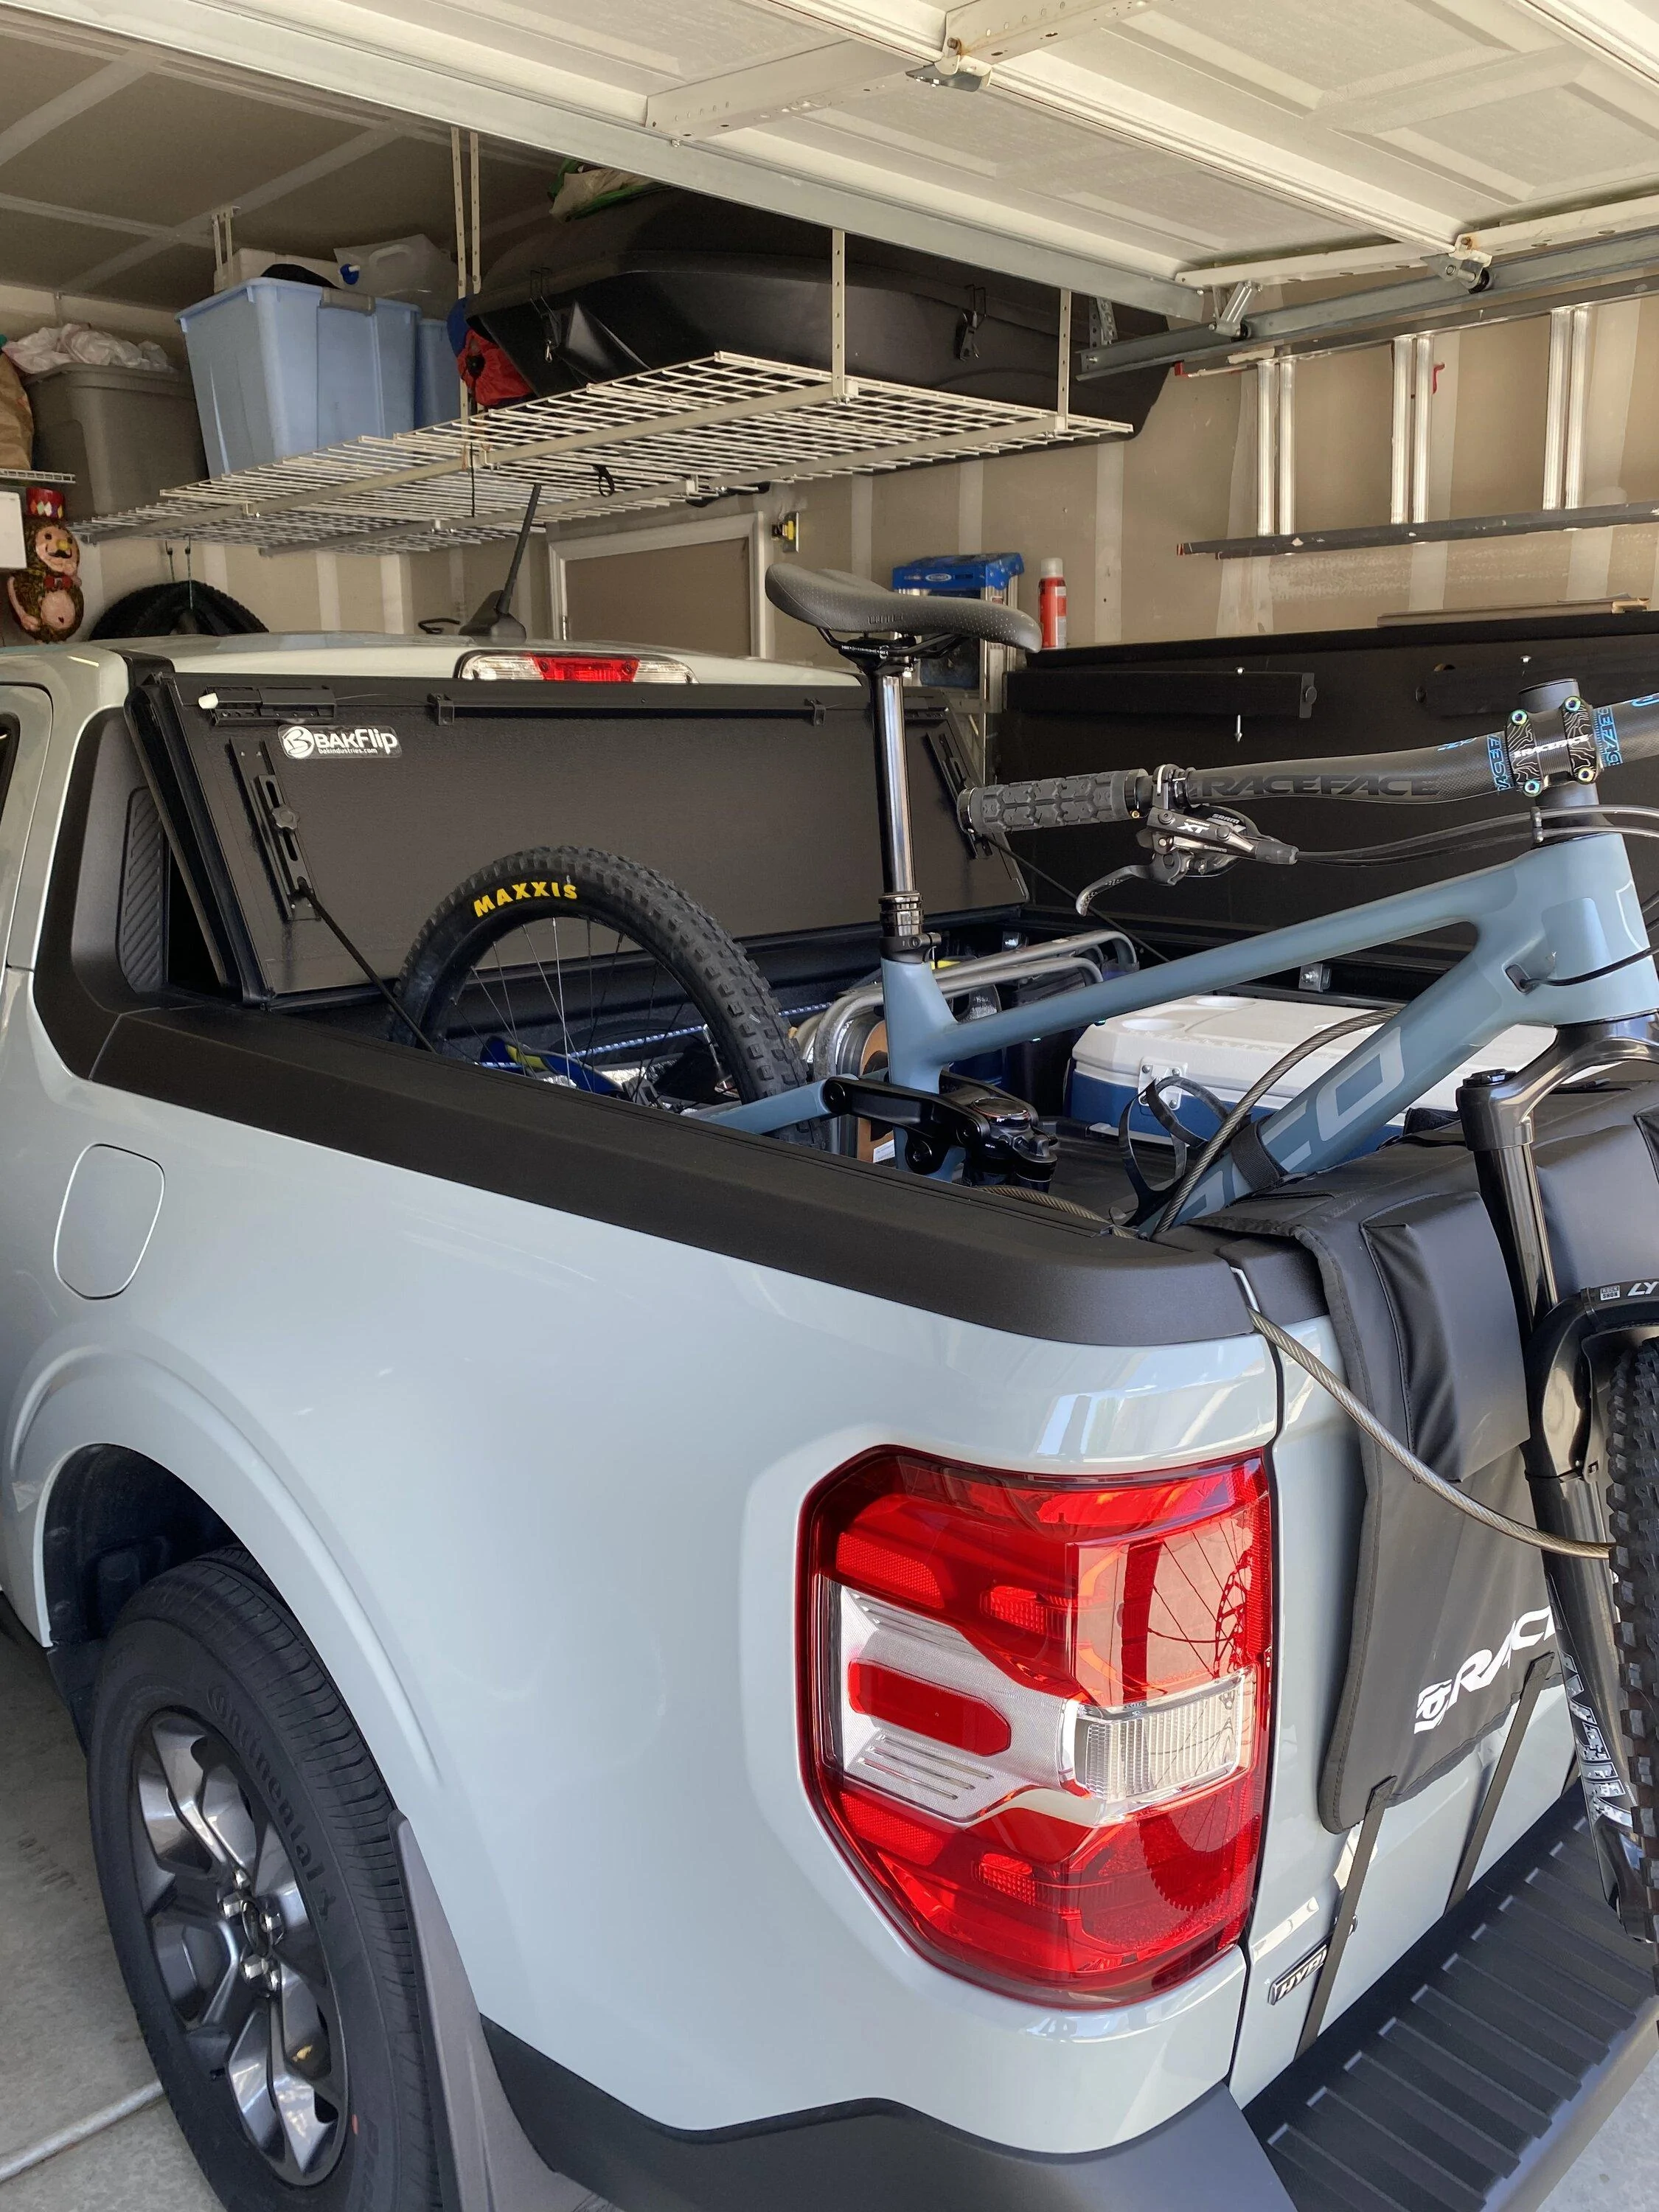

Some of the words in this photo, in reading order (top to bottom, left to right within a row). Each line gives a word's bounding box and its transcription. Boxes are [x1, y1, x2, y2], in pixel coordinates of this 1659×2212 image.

[313, 728, 398, 754] BAKFlip
[1202, 774, 1439, 797] RACEFACE
[1177, 822, 1210, 834] XT
[1211, 813, 1240, 824] SRAM
[473, 881, 577, 917] MAXXIS
